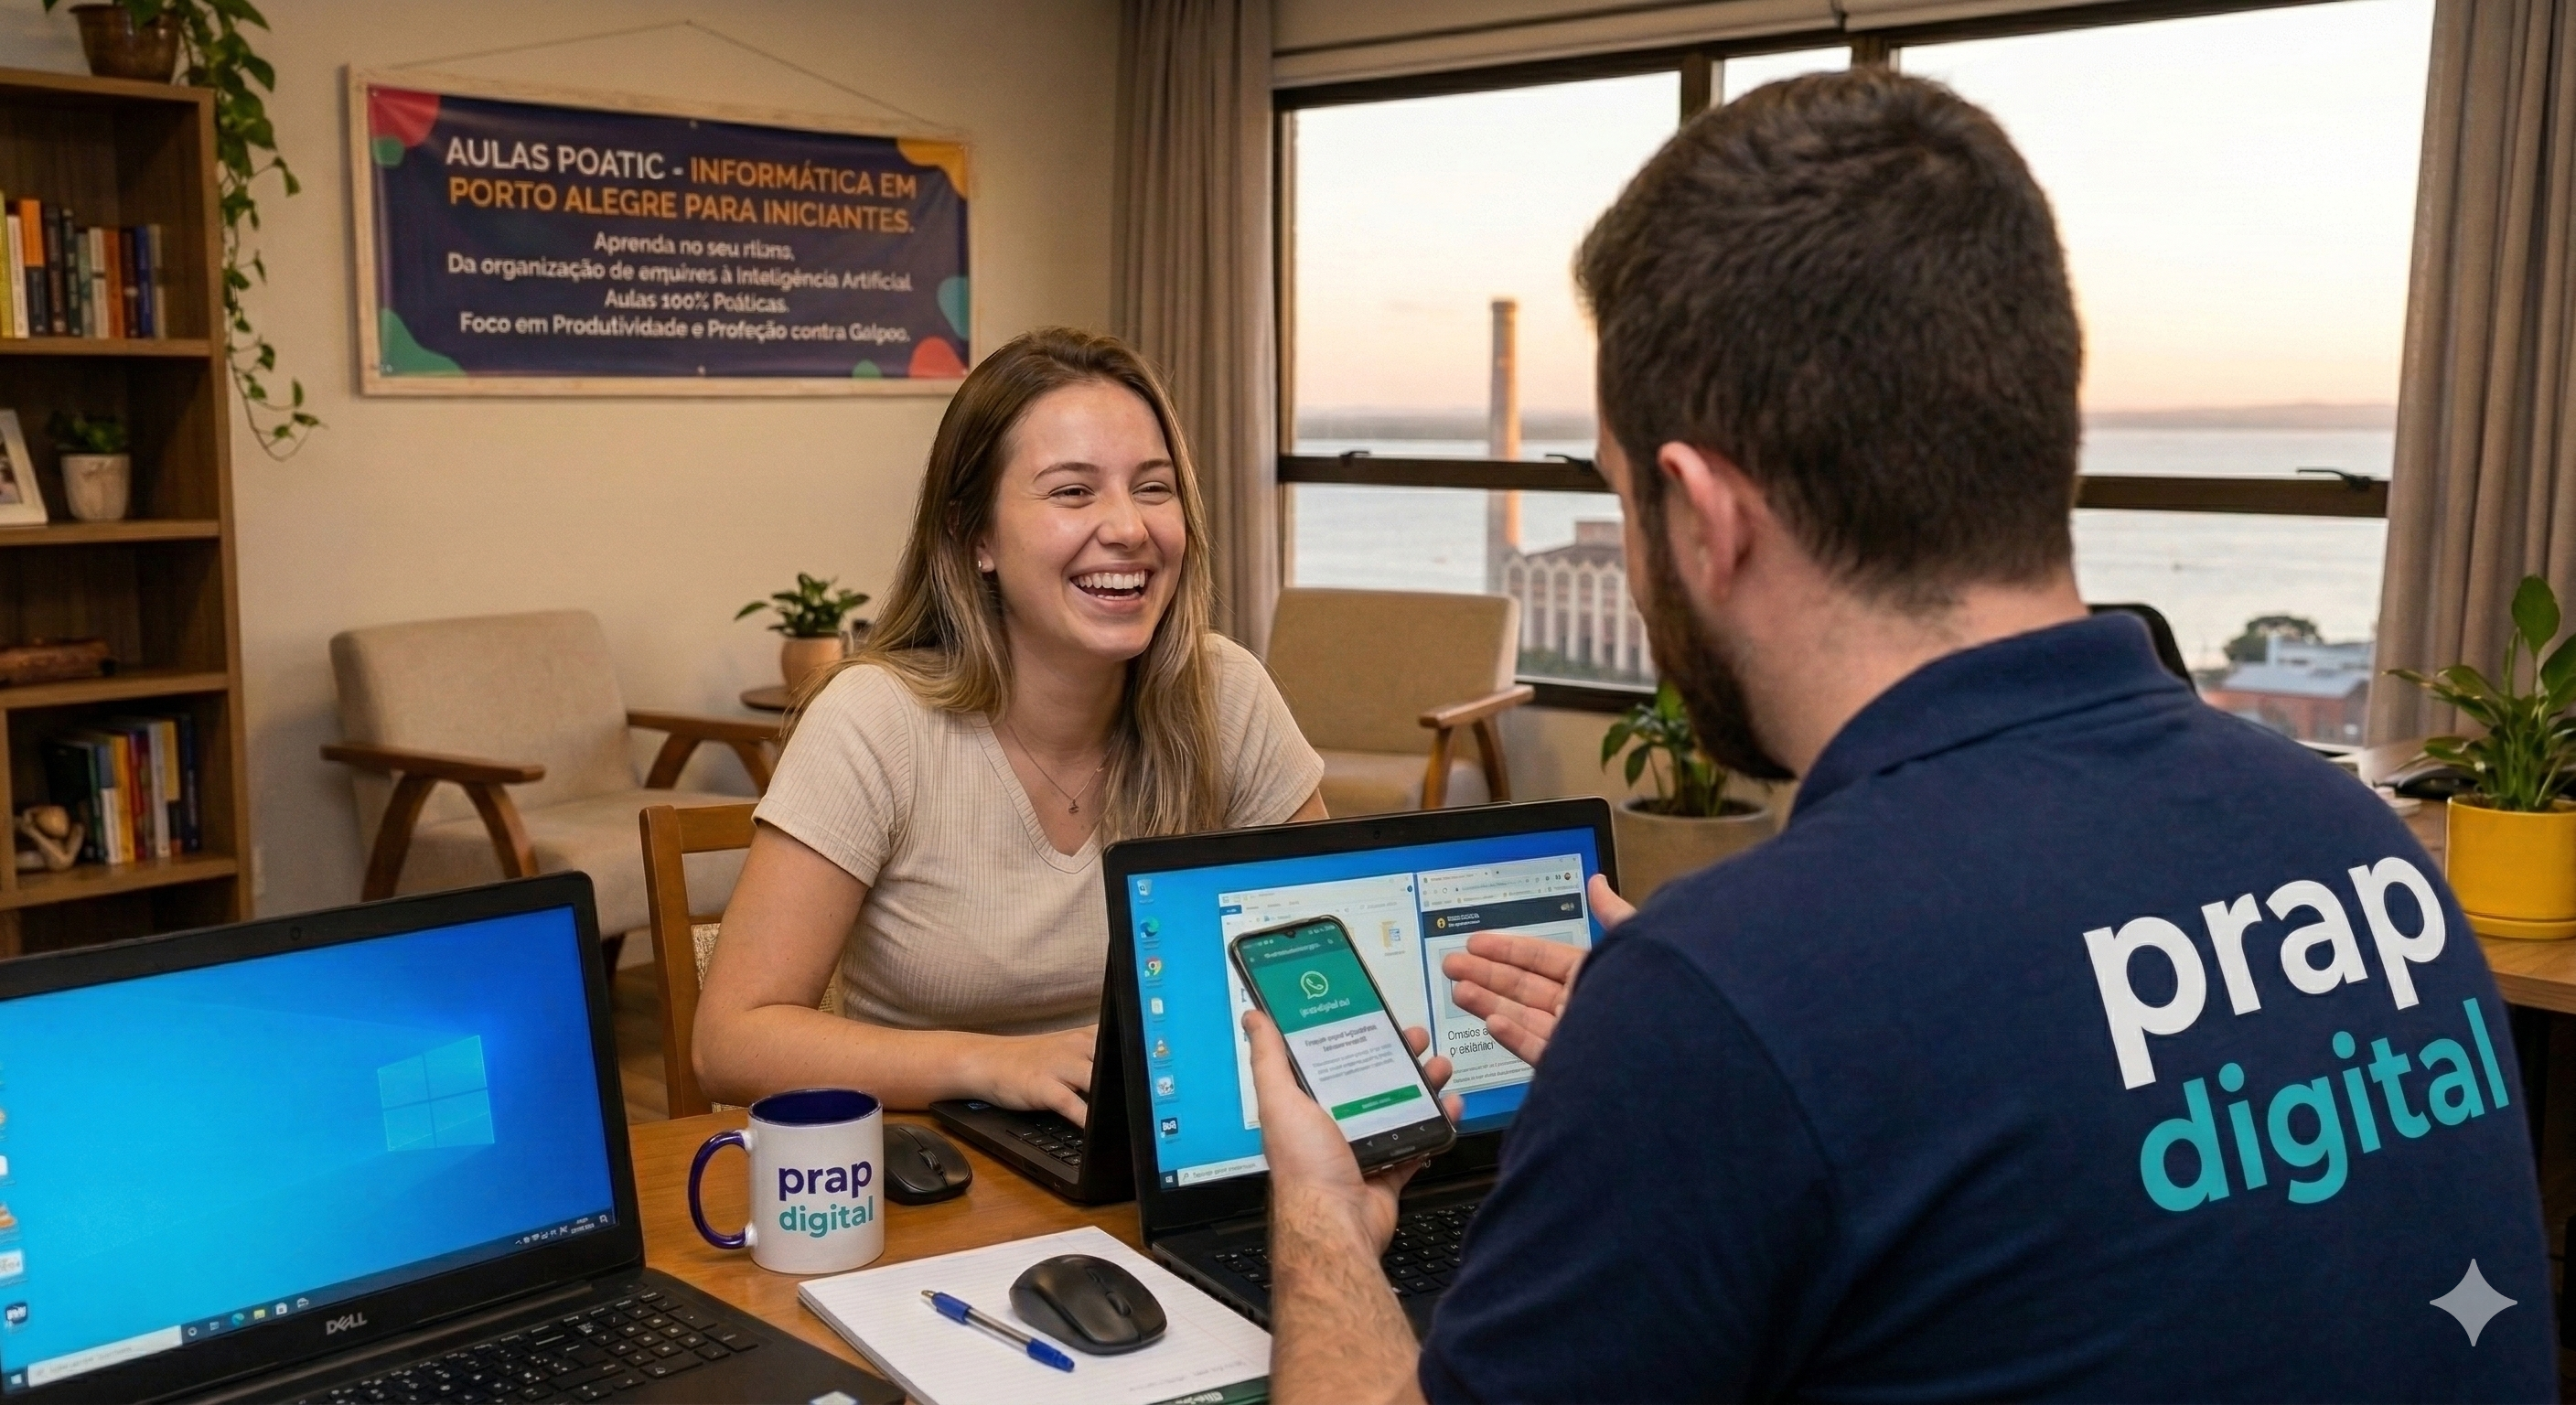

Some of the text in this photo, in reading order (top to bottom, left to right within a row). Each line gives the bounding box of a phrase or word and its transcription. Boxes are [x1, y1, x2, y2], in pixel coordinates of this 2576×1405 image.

[446, 137, 551, 172] AULAS
[557, 145, 666, 180] POATIC
[691, 157, 875, 197] INFORMÁTICA
[880, 172, 917, 200] EM
[449, 177, 915, 233] PORTO ALEGRE PARA INICIANTES.
[594, 231, 676, 256] Aprenda
[679, 239, 703, 256] no
[707, 241, 740, 258] seu
[447, 252, 478, 273] Da
[481, 255, 606, 283] organização
[609, 260, 635, 281] de
[604, 288, 658, 309] Aulas
[660, 292, 710, 312] 100%
[460, 311, 511, 335] Foco
[515, 316, 548, 335] em
[553, 314, 688, 338] Produtividade
[691, 322, 704, 338] e
[790, 323, 847, 341] contra
[2083, 856, 2447, 1090] prap
[2140, 997, 2510, 1212] digital
[778, 1161, 872, 1201] prap
[779, 1196, 873, 1238] digital
[326, 1312, 368, 1335] DELL
